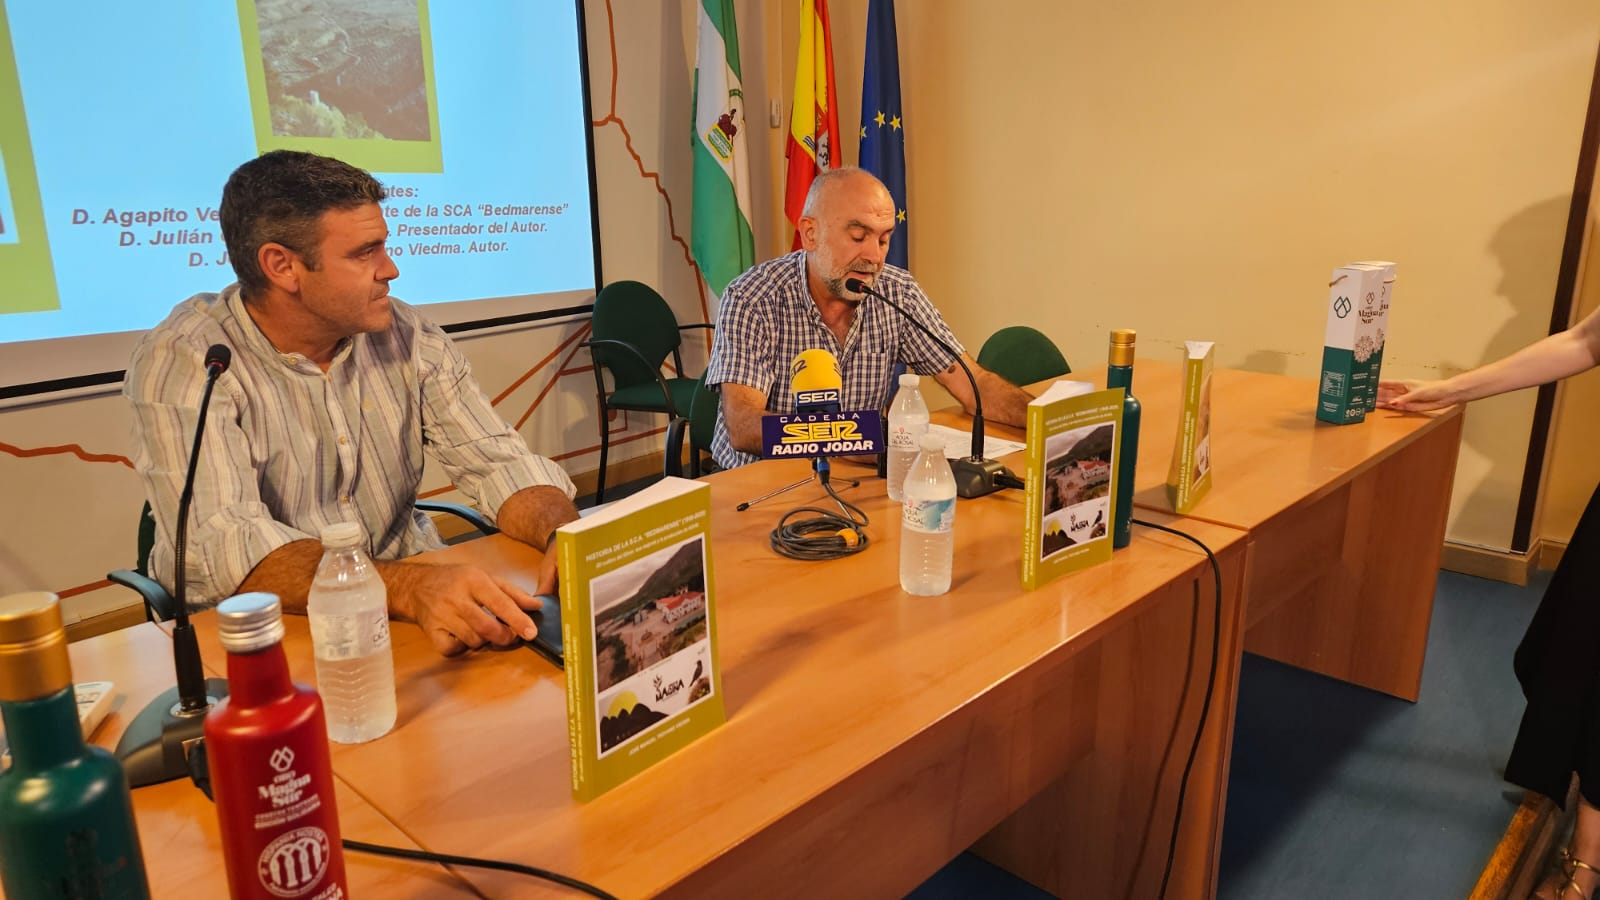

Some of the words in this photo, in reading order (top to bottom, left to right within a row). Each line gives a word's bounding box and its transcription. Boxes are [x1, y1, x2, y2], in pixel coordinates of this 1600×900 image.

[71, 208, 96, 225] D.
[102, 207, 189, 228] Agapito
[403, 203, 422, 217] de
[425, 204, 439, 217] la
[443, 203, 473, 217] SCA
[478, 202, 569, 217] “Bedmarense”
[119, 230, 142, 247] D.
[148, 228, 213, 246] Julián
[396, 222, 485, 237] Presentador
[487, 221, 508, 234] del
[511, 220, 548, 234] Autor.
[188, 251, 209, 267] D.
[408, 242, 466, 257] Viedma.
[468, 241, 509, 254] Autor.
[798, 390, 838, 404] SER
[779, 411, 861, 424] CADENA
[781, 420, 863, 444] SER
[771, 442, 820, 457] RADIO
[822, 439, 874, 453] JODAR
